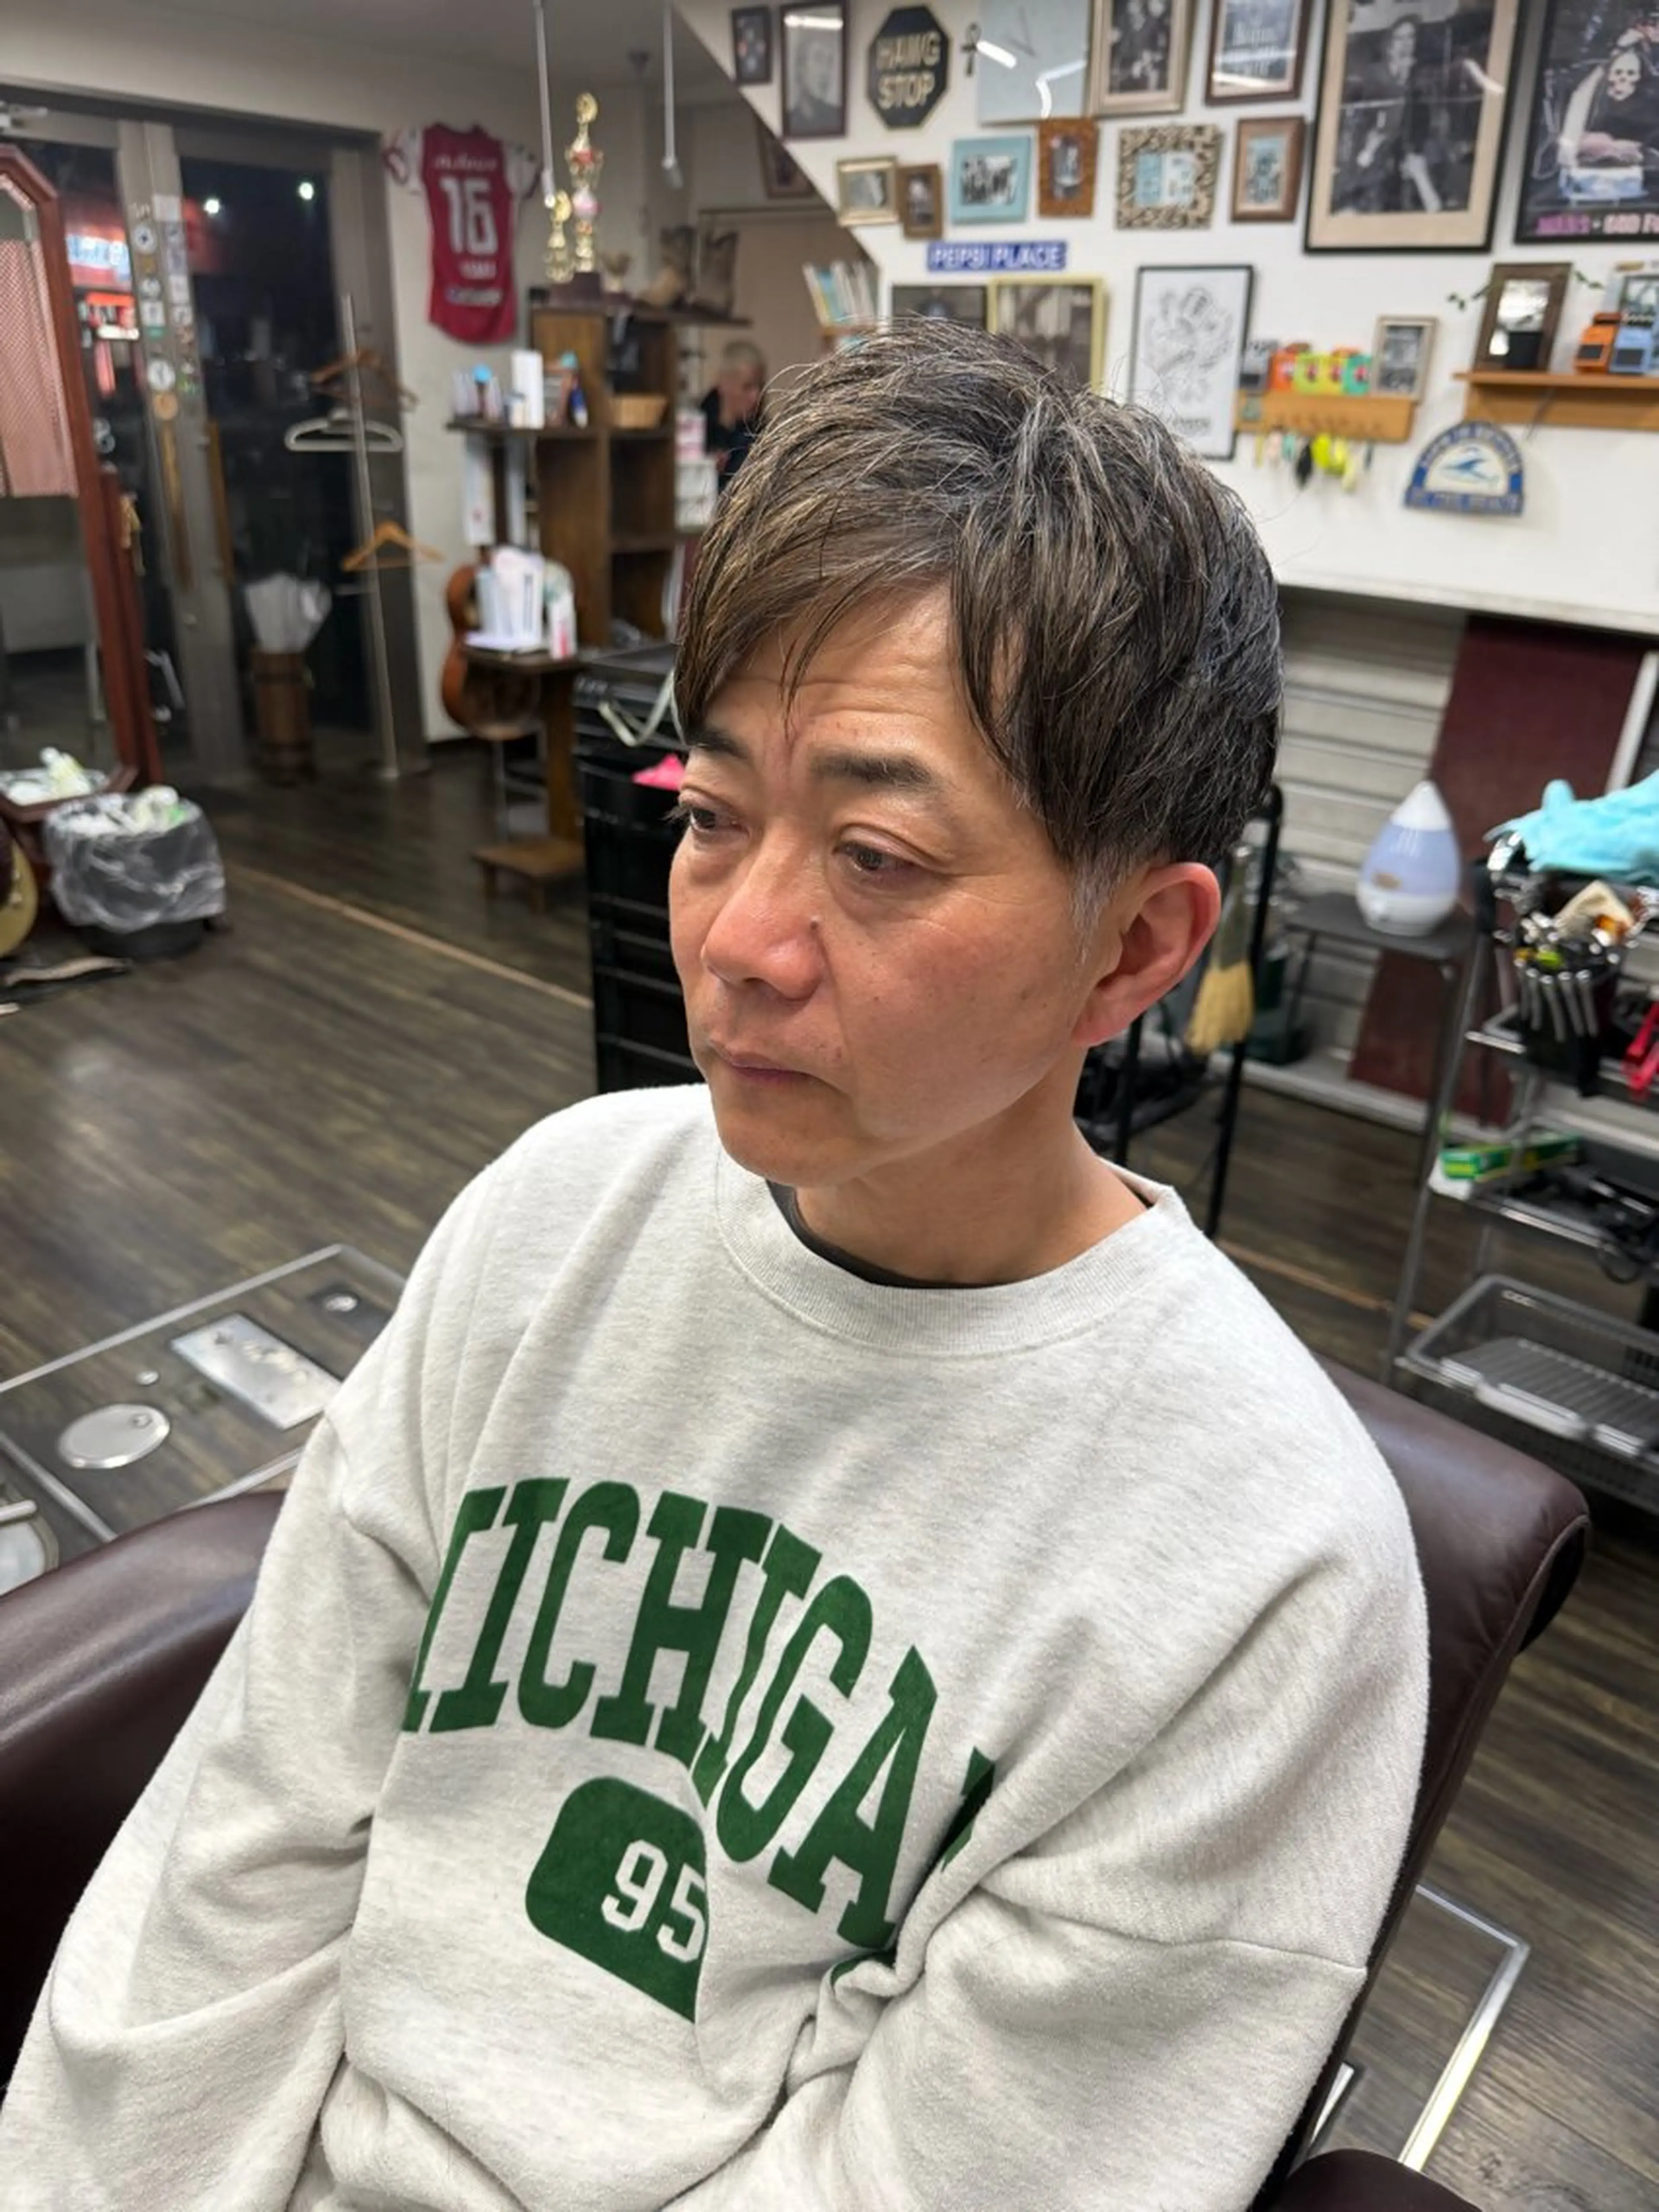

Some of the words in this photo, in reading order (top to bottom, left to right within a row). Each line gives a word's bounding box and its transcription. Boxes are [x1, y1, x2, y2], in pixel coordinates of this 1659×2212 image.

[878, 70, 935, 109] STOP
[439, 178, 499, 255] 16
[995, 245, 1062, 269] PLACE
[402, 1478, 995, 1950] ICHIGA
[601, 1839, 706, 1963] 95
